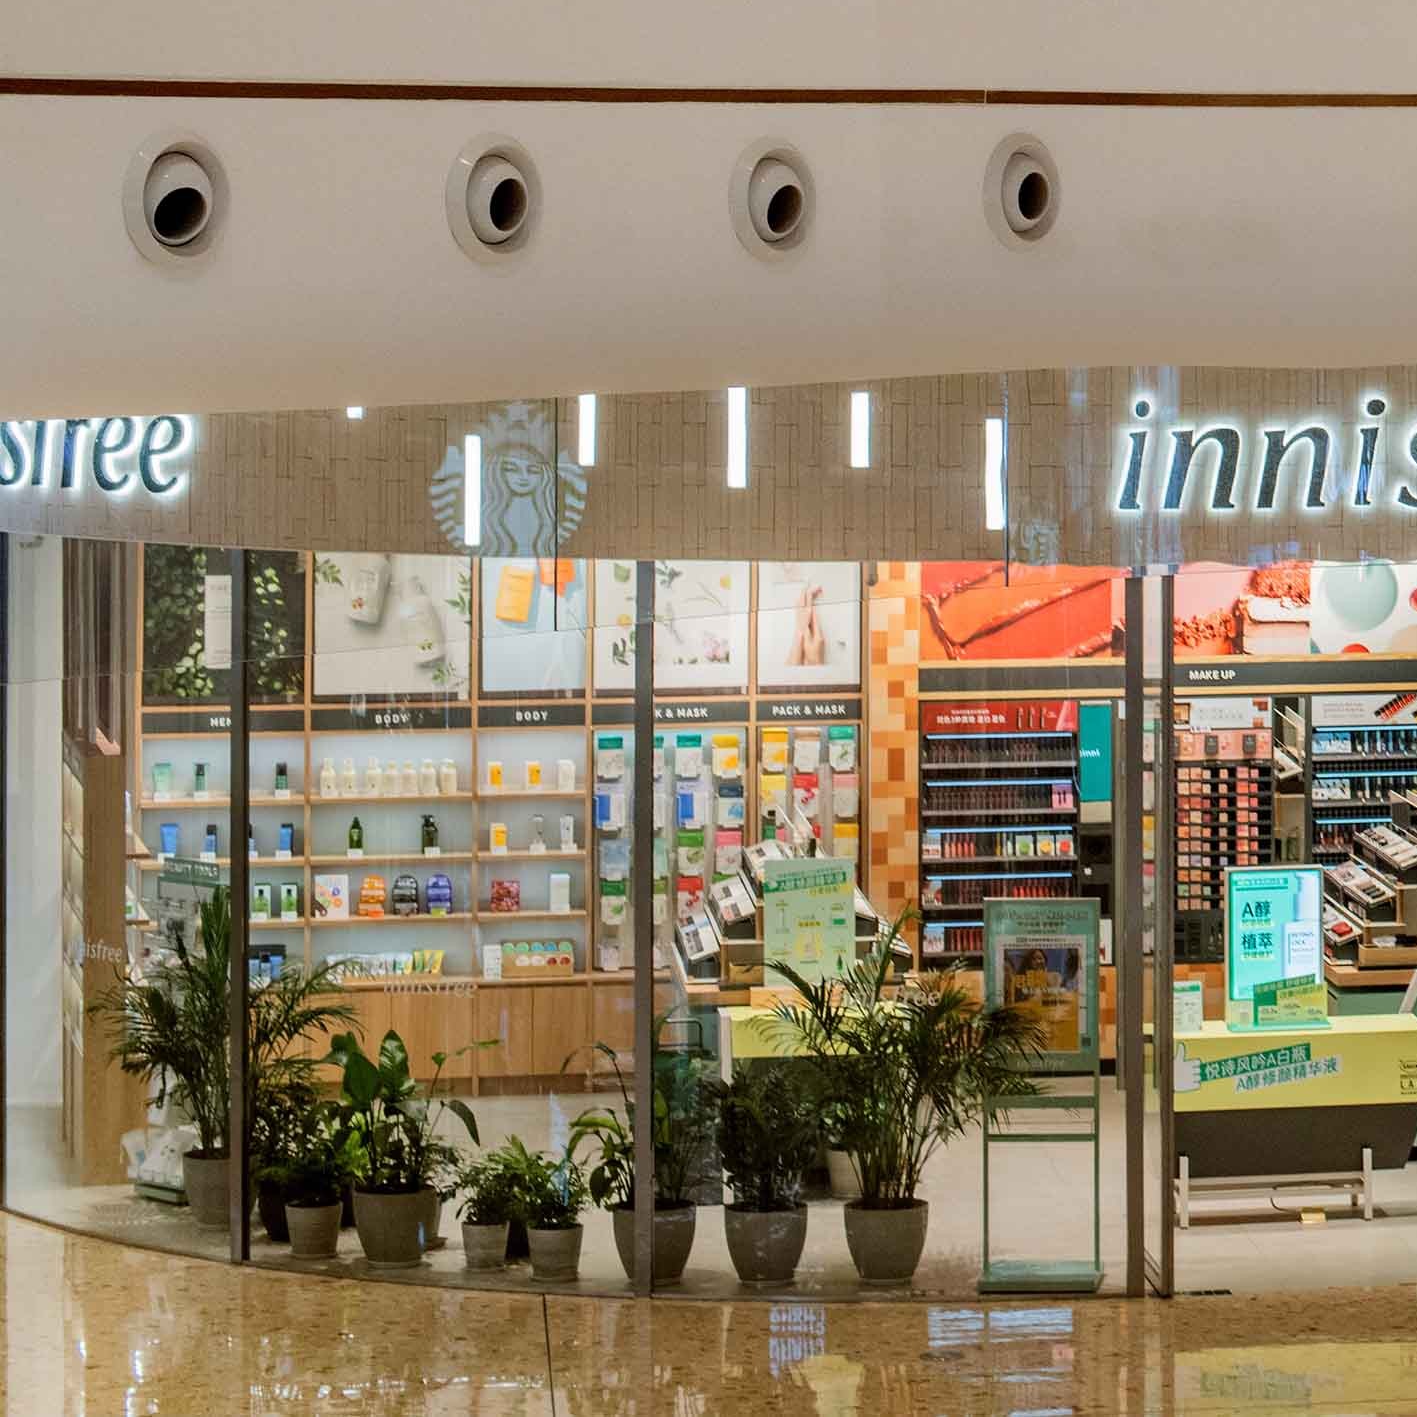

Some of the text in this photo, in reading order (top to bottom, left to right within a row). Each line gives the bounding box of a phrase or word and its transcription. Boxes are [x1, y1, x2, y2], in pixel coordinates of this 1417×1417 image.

[1188, 669, 1237, 681] MAKE UP
[772, 704, 801, 716] PACK
[815, 704, 846, 716] MASK
[375, 713, 410, 726] BODY
[516, 710, 549, 723] BODY
